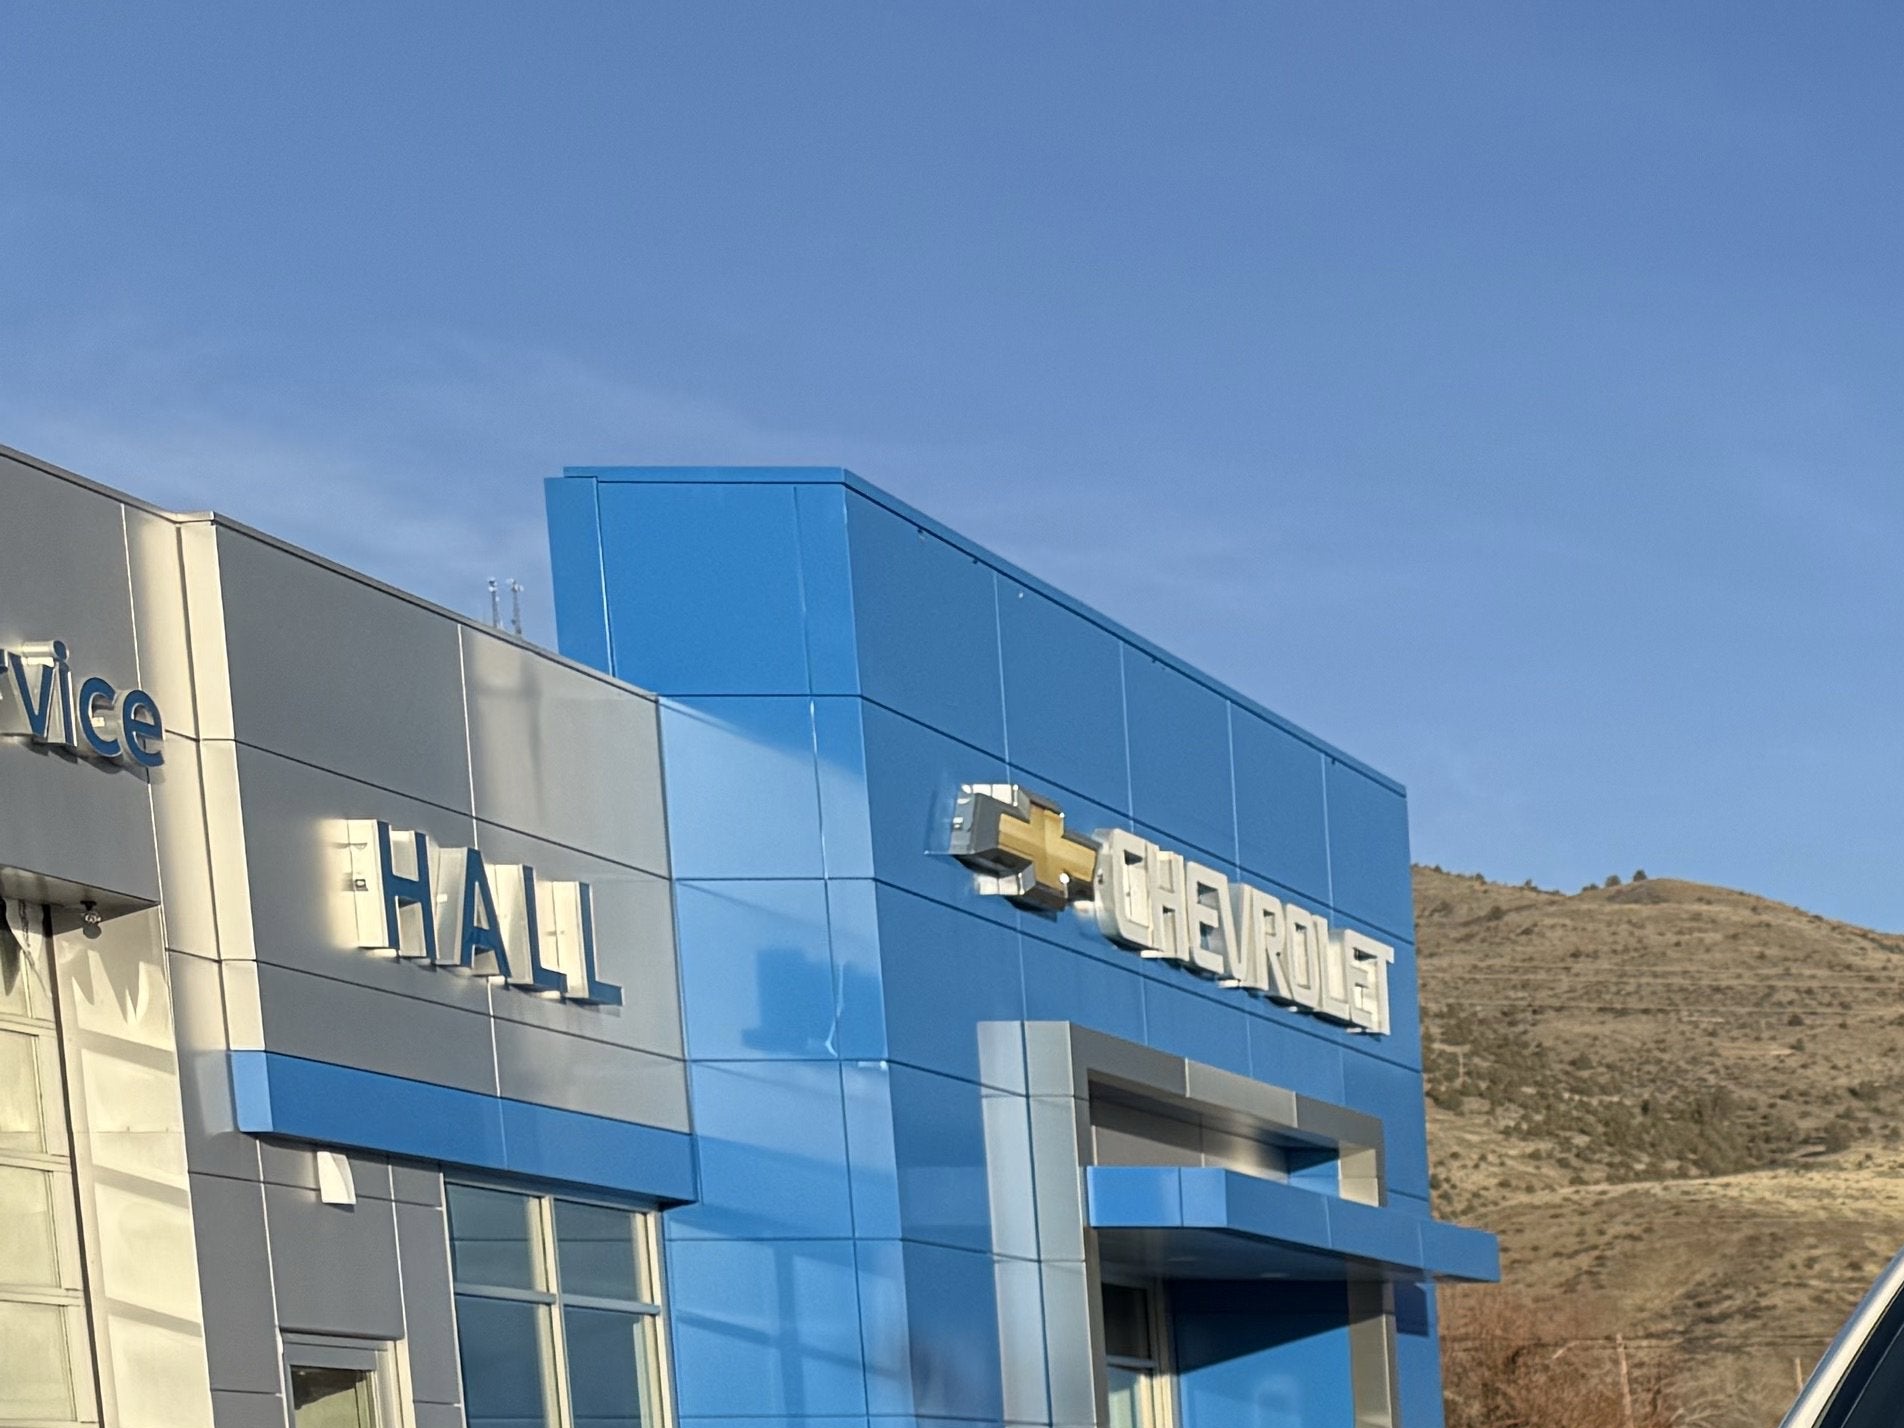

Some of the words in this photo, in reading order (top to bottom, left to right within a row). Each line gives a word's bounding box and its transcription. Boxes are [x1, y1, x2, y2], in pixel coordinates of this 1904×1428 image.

[0, 640, 165, 767] vice
[376, 819, 623, 1006] HALL
[1106, 828, 1394, 1036] CHEVROLET
